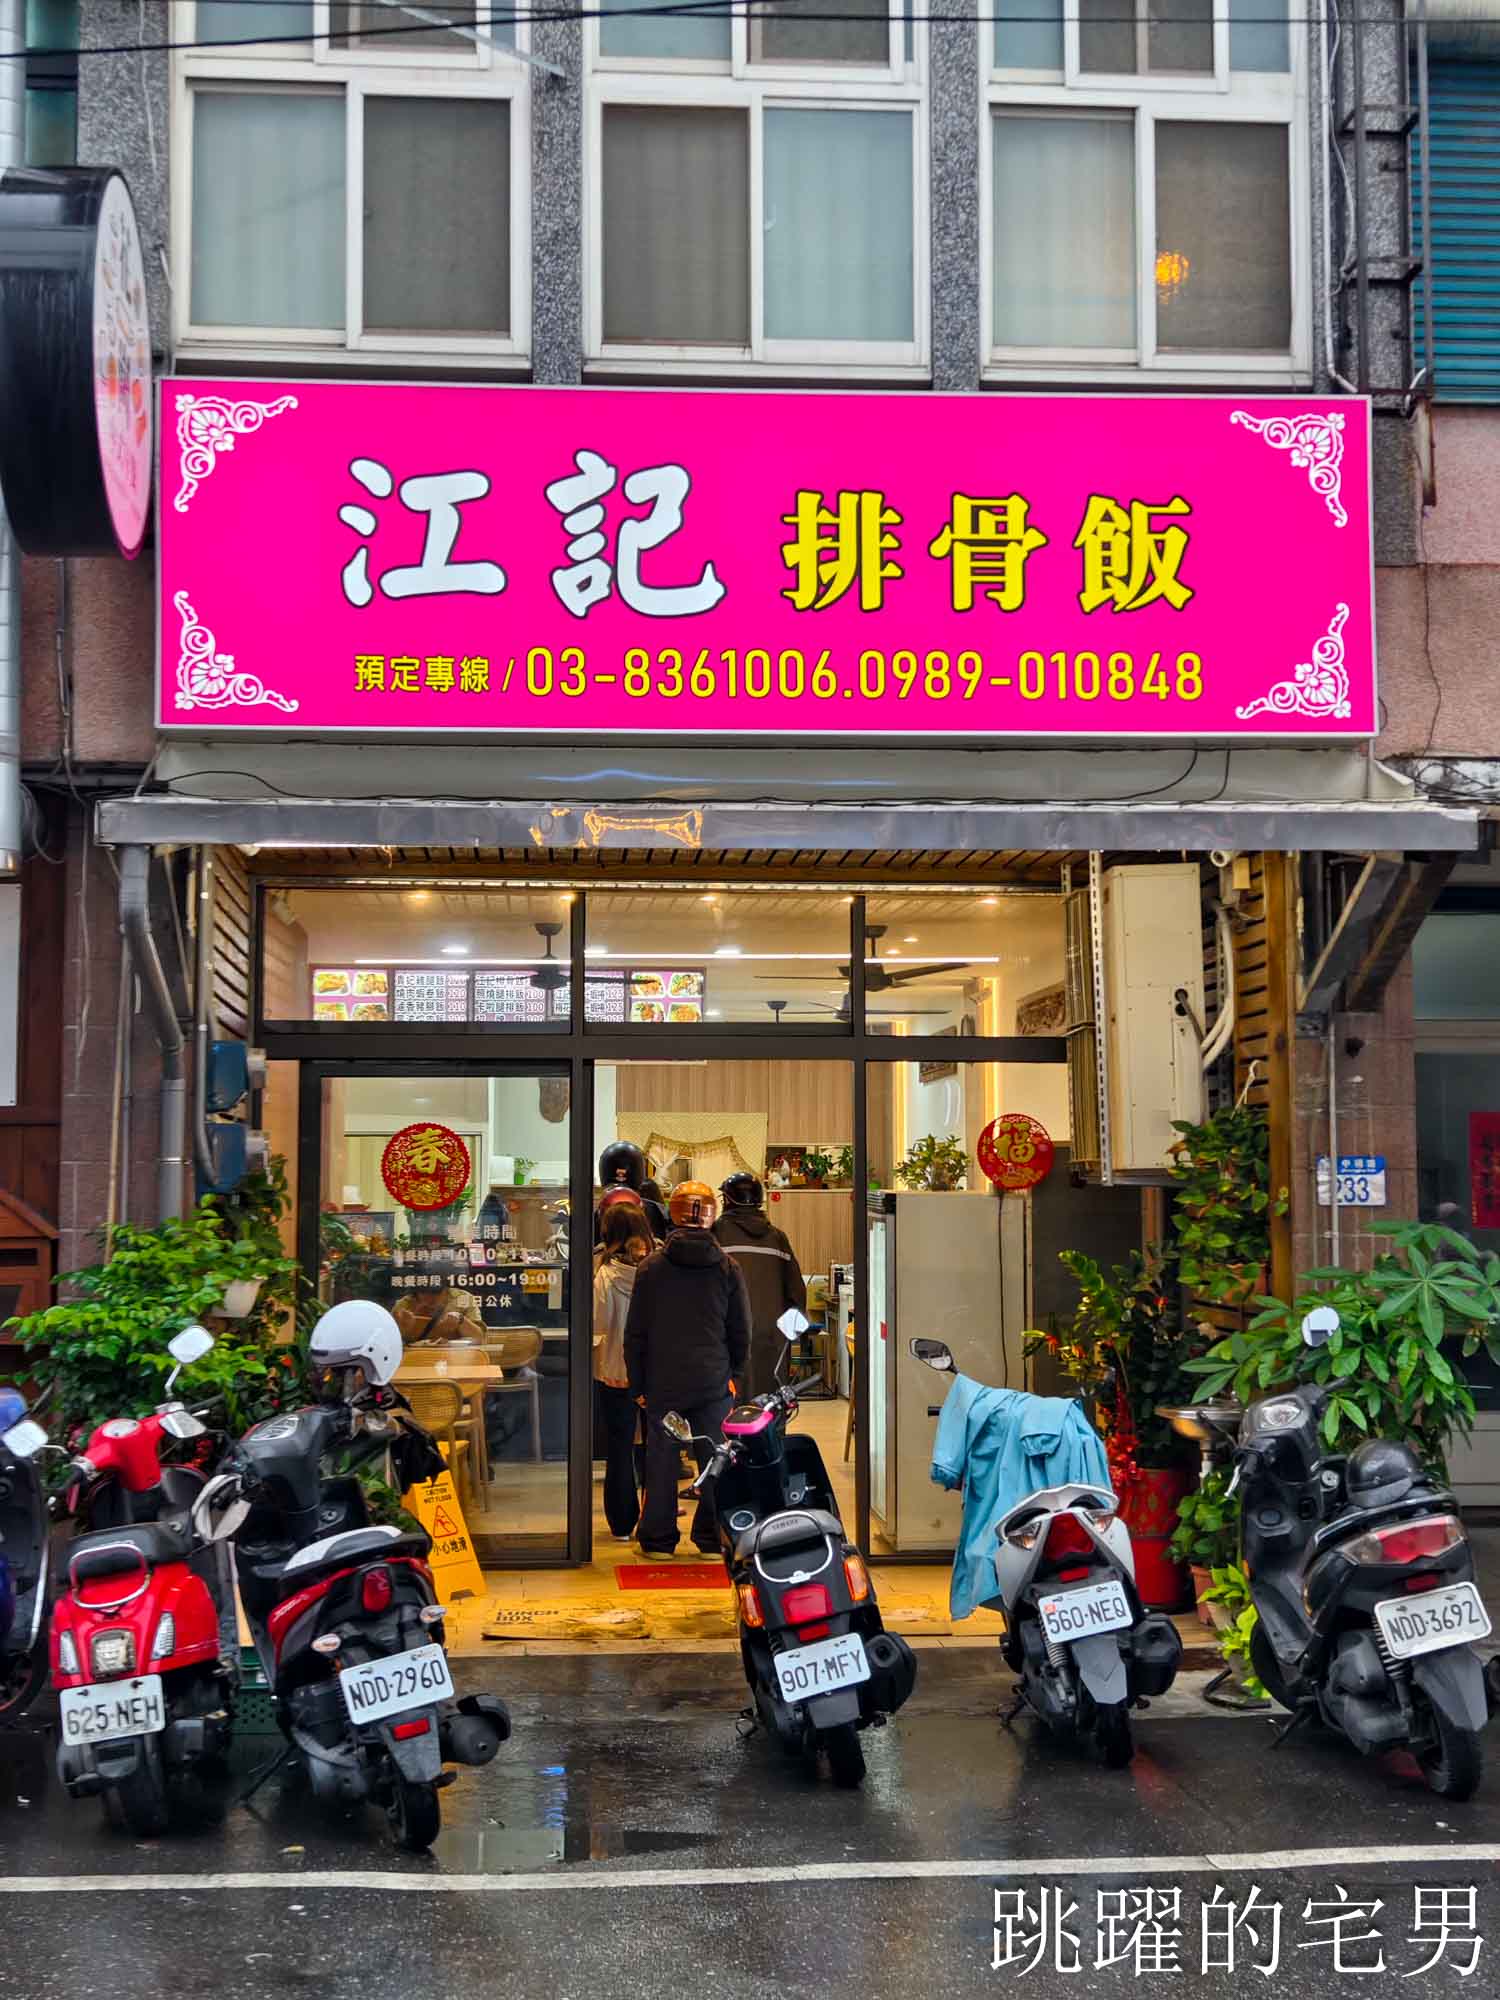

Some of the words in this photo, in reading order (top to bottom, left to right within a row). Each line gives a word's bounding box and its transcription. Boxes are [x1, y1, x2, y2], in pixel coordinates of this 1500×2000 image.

[340, 449, 726, 618] 江記
[780, 490, 1194, 615] 排骨飯
[354, 654, 490, 693] 預定專線
[405, 1127, 451, 1174] 春
[993, 1121, 1036, 1163] 福
